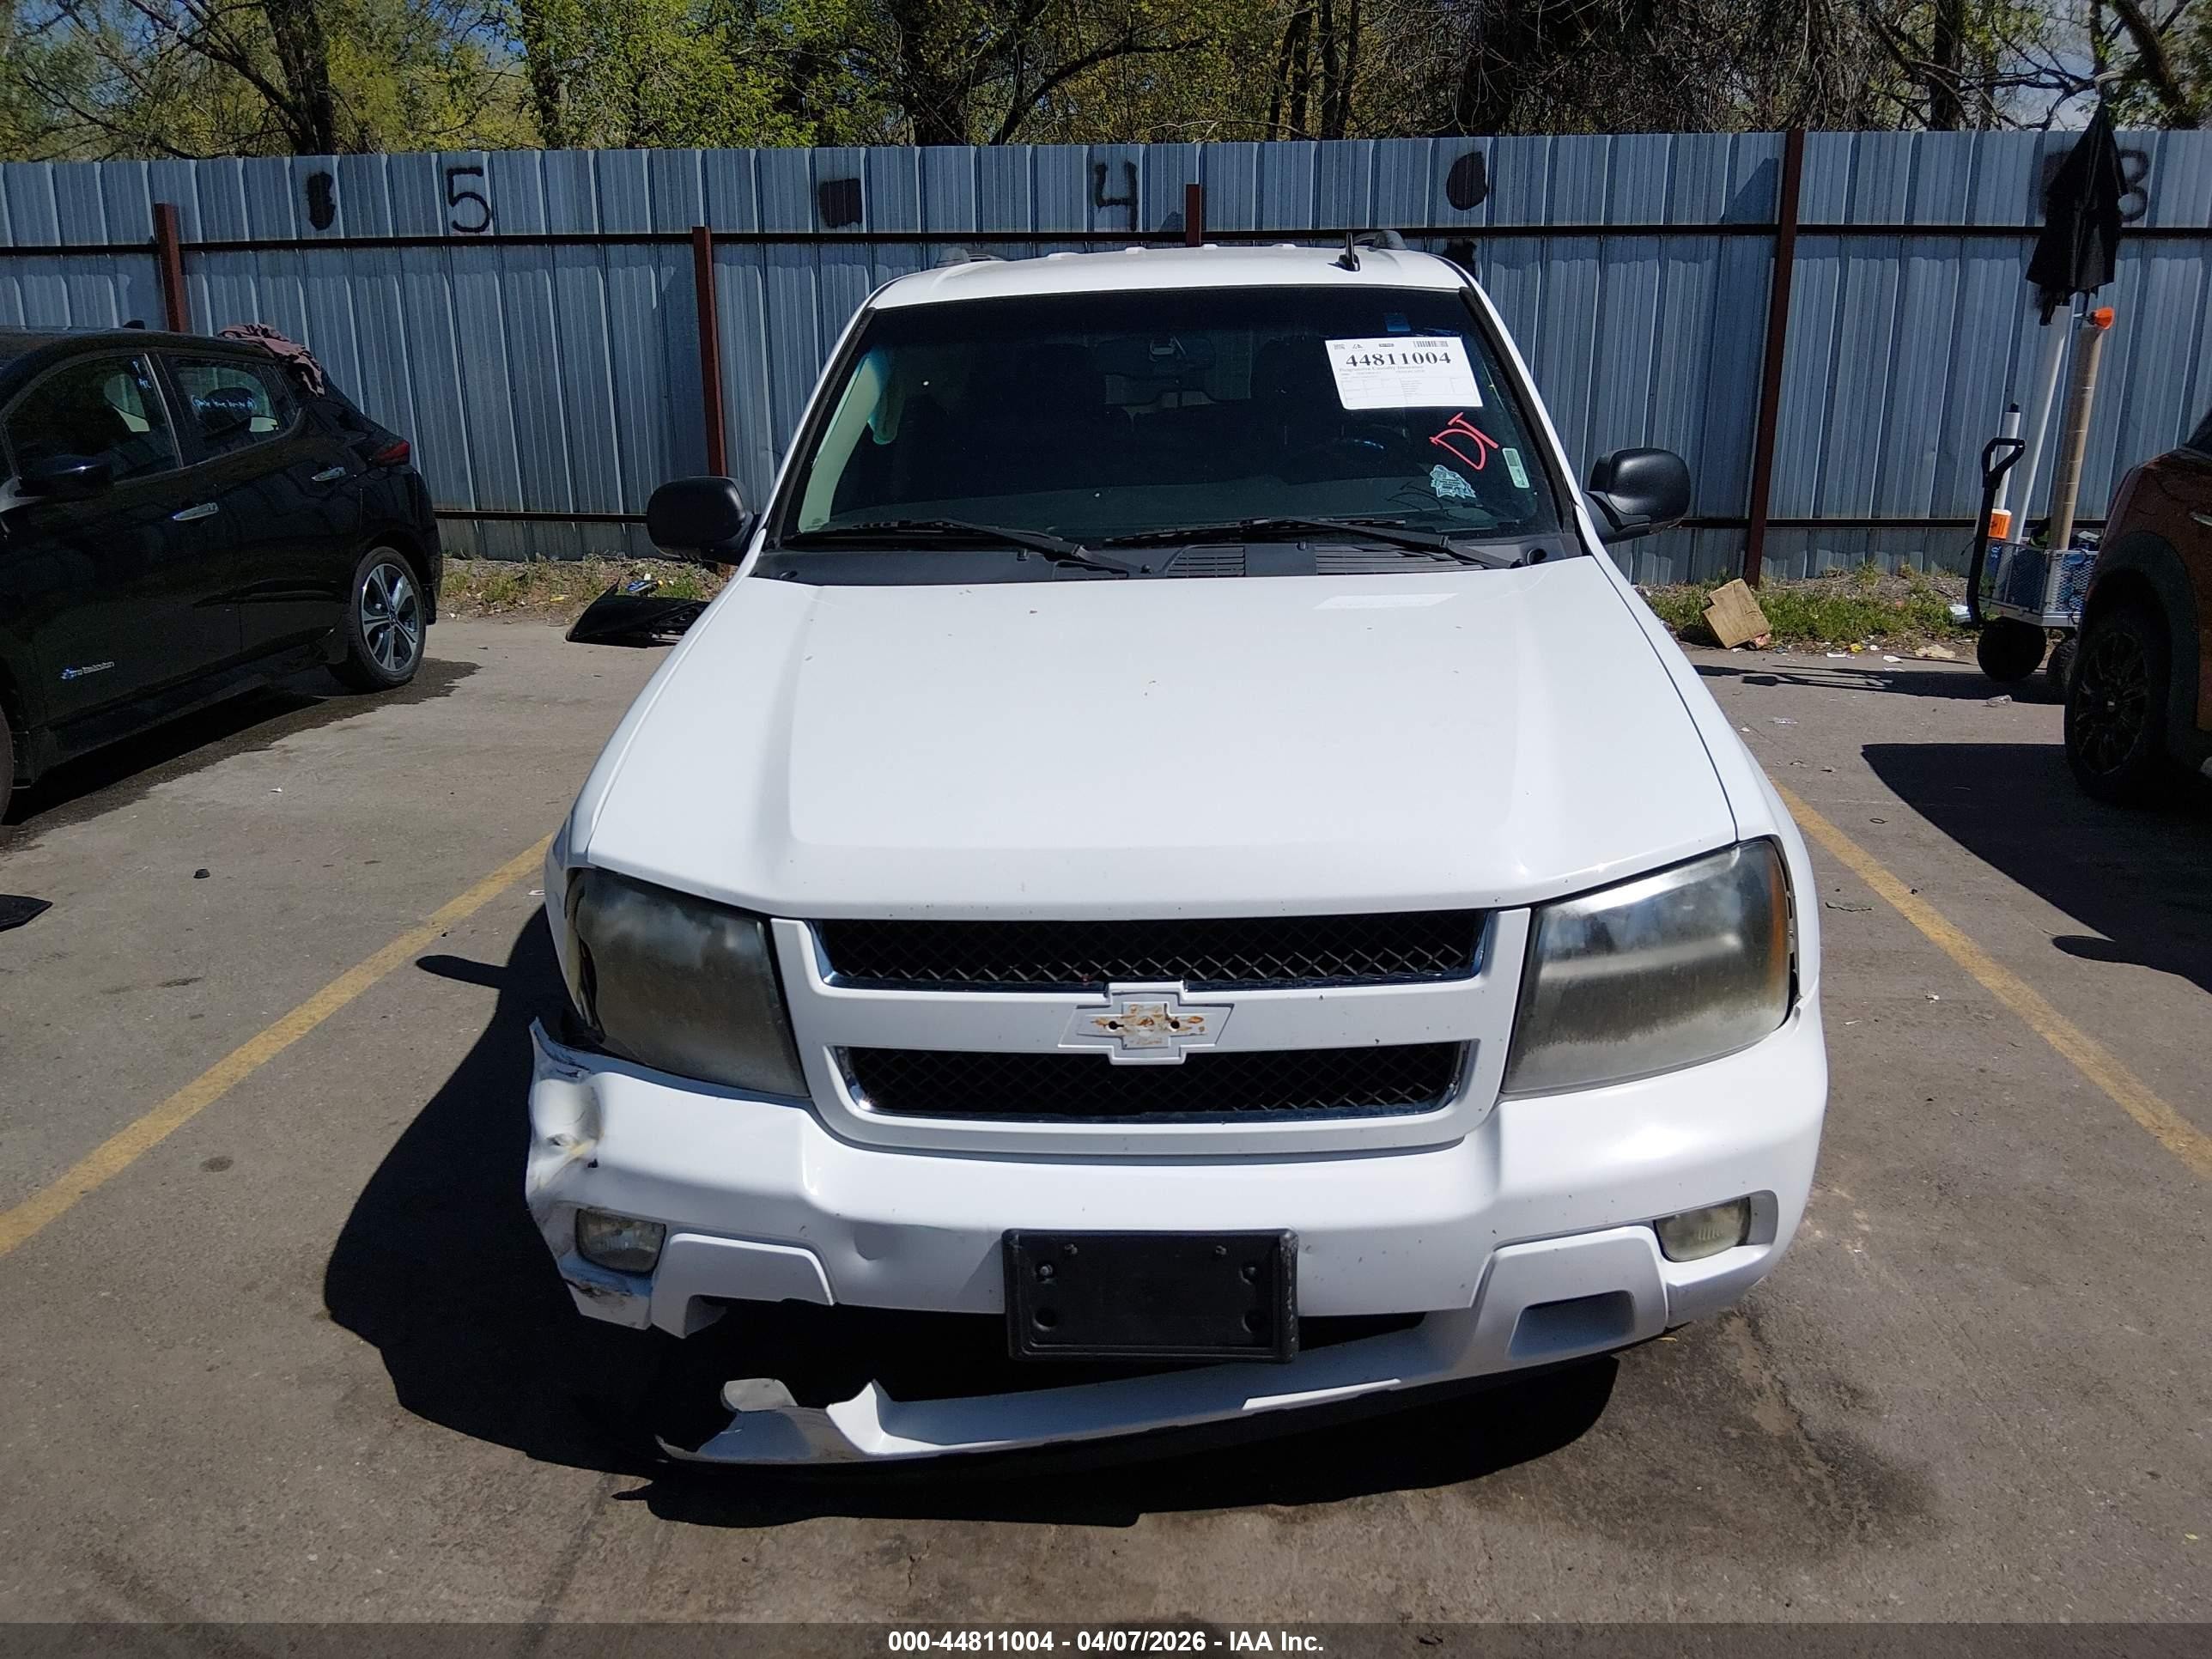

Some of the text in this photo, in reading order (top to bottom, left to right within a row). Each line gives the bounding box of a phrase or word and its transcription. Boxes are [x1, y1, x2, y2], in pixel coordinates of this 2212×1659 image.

[447, 167, 492, 233] 5
[1093, 160, 1138, 232] 4
[1346, 351, 1451, 367] 44811004
